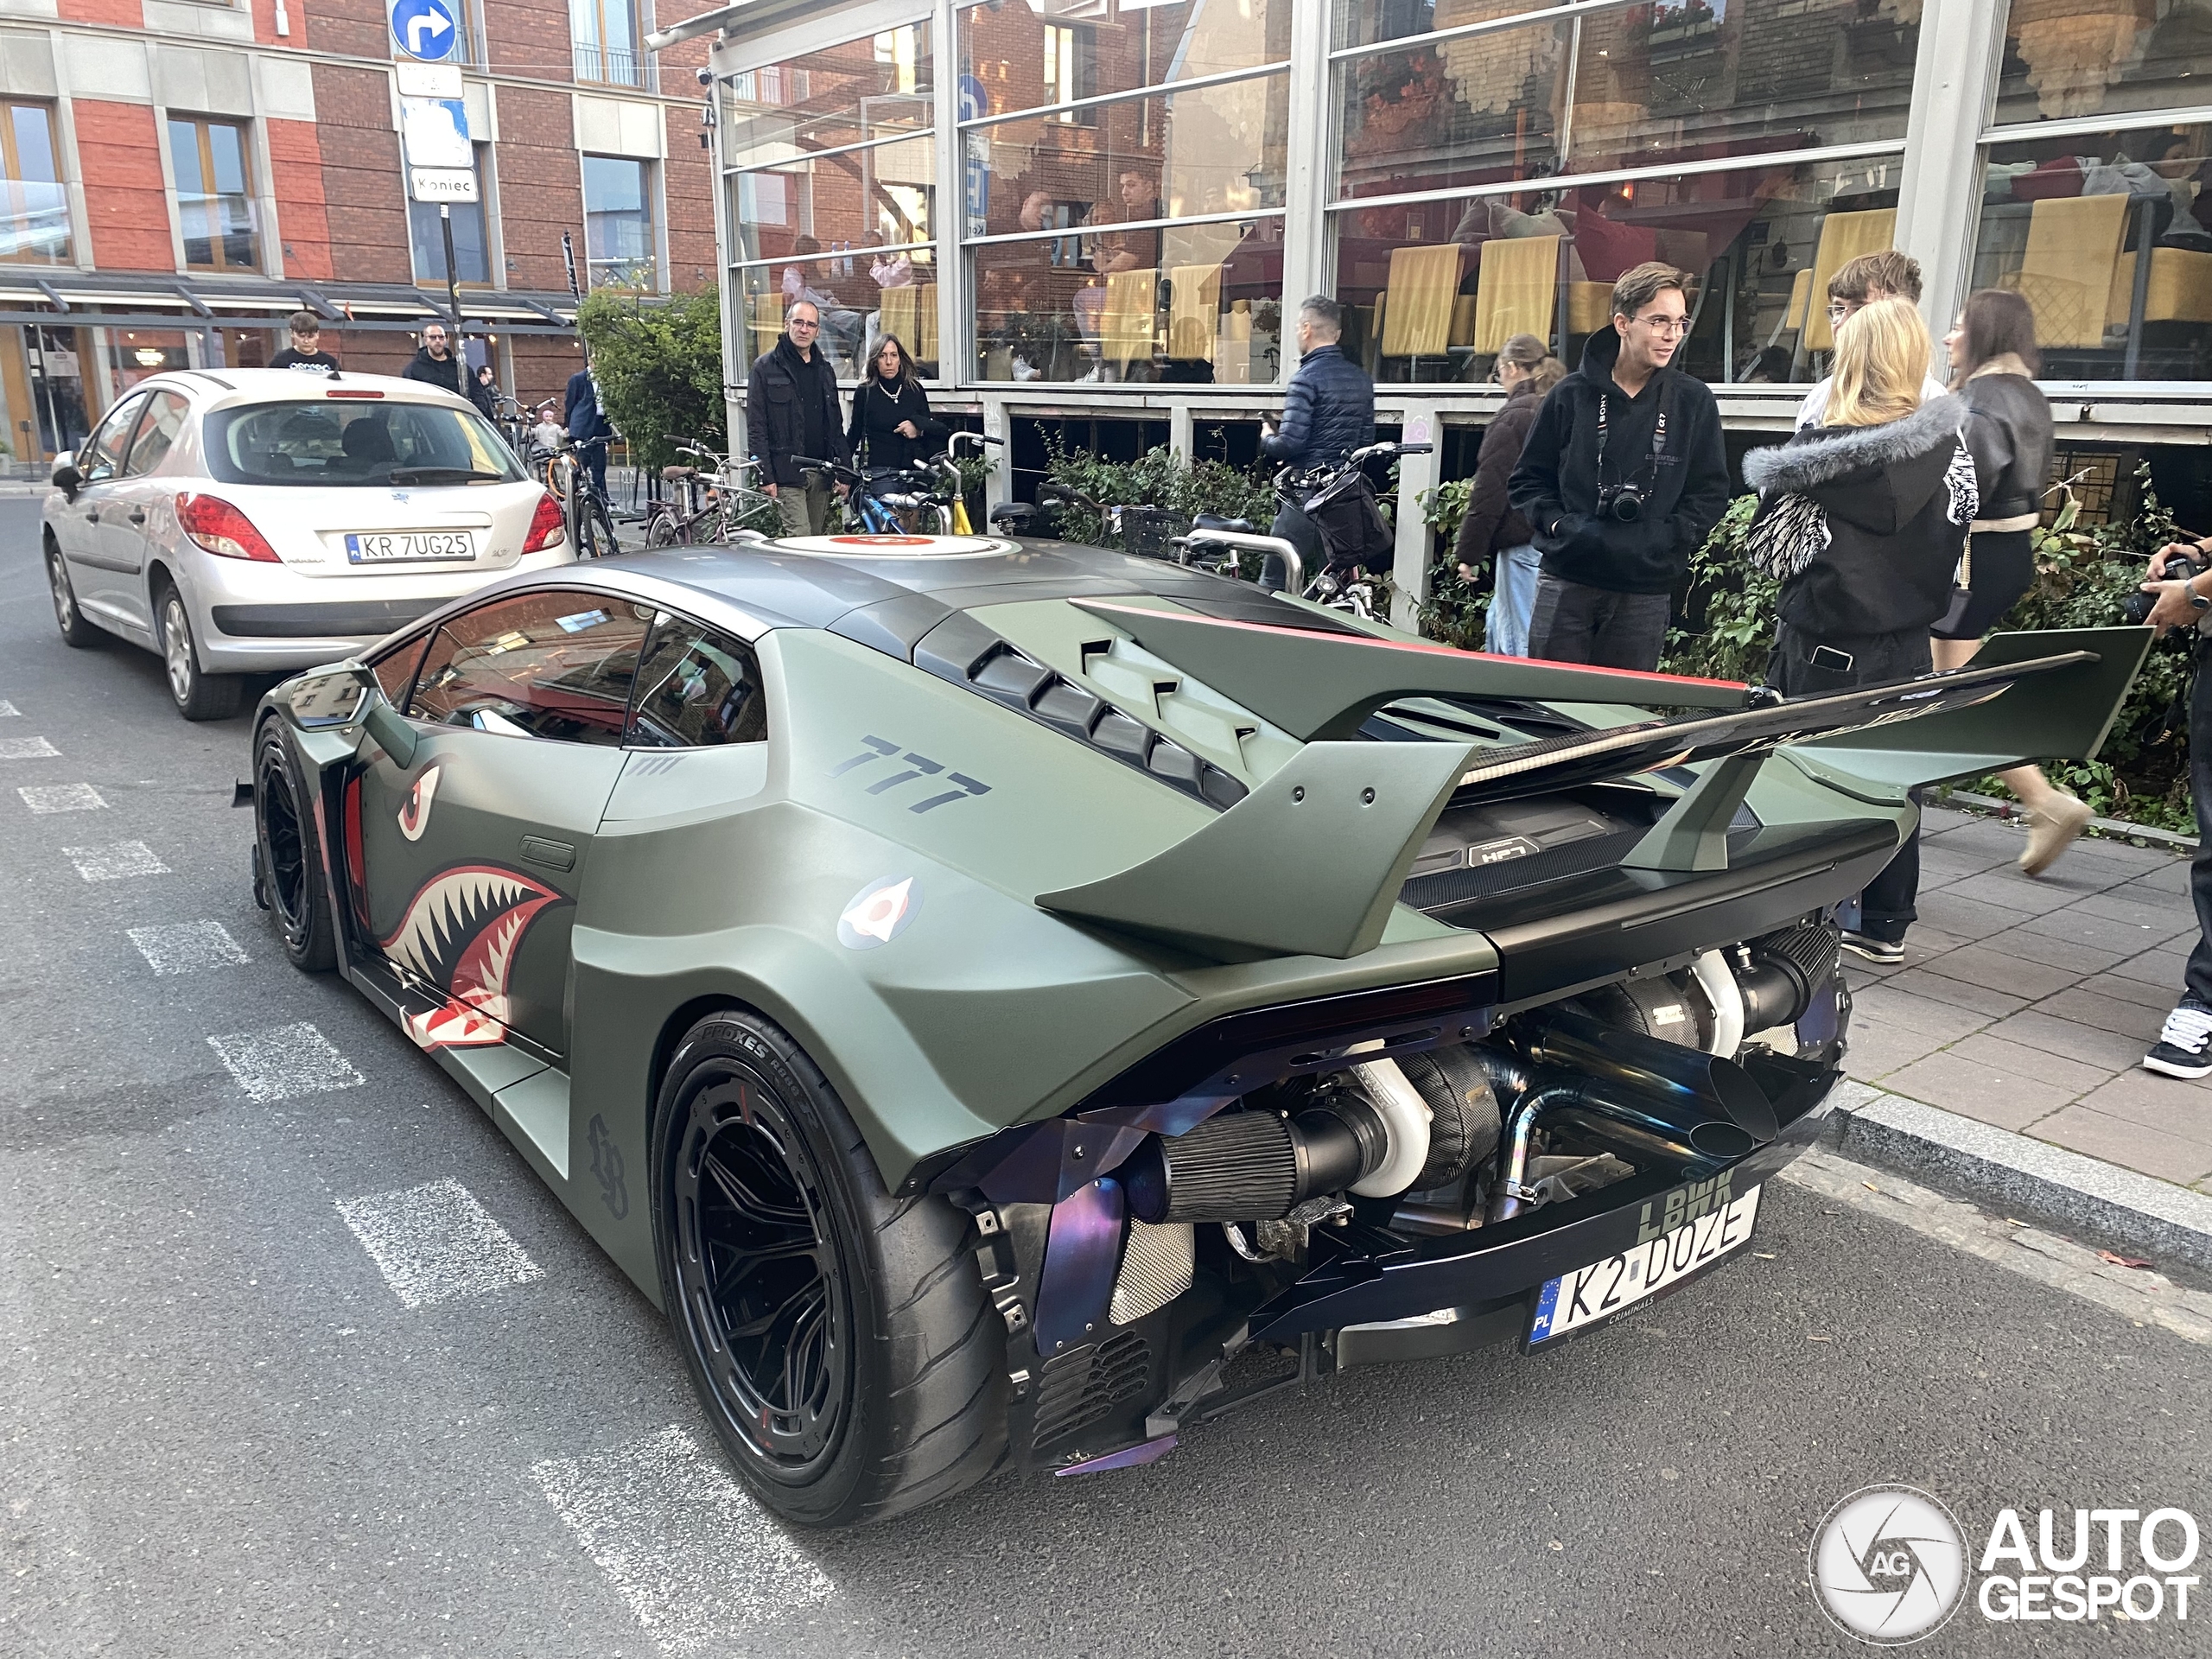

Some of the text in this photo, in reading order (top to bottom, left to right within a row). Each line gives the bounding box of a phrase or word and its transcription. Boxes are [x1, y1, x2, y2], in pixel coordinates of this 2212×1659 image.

[418, 178, 470, 192] Koniec
[364, 535, 467, 556] KR 7UG25
[825, 734, 993, 814] 777
[702, 1025, 769, 1059] PROXES
[1637, 1167, 1736, 1245] LBWK
[1567, 1254, 1626, 1323] K2
[1533, 1314, 1550, 1332] PL
[1609, 1296, 1654, 1325] CRIMINALS
